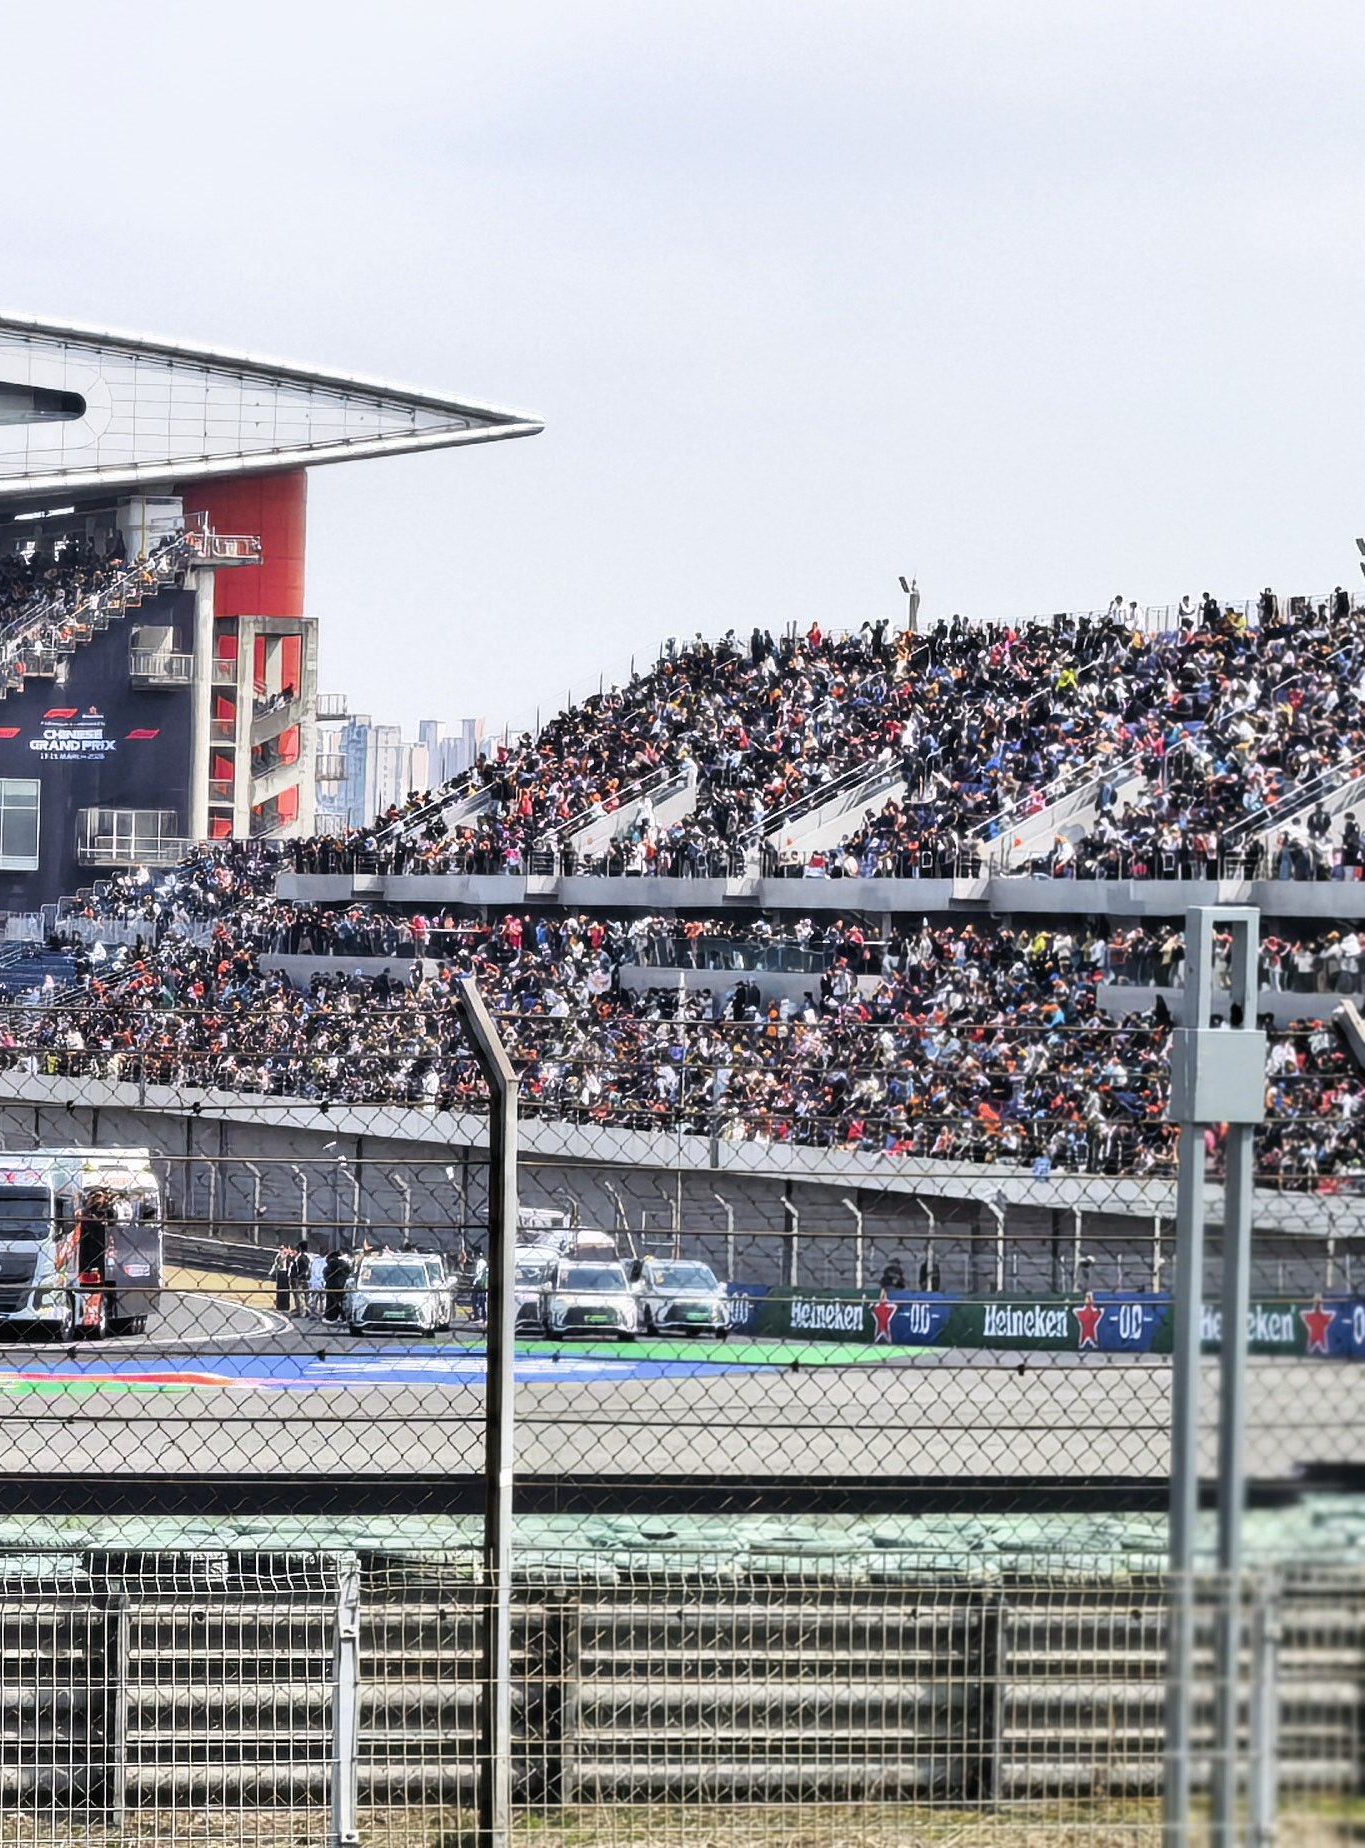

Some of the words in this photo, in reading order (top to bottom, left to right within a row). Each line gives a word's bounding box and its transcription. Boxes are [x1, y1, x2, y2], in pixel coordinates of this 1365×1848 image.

[29, 740, 80, 751] GRAND
[82, 740, 116, 751] PRIX
[790, 1295, 864, 1332] Heineken
[983, 1303, 1069, 1338] Heineken
